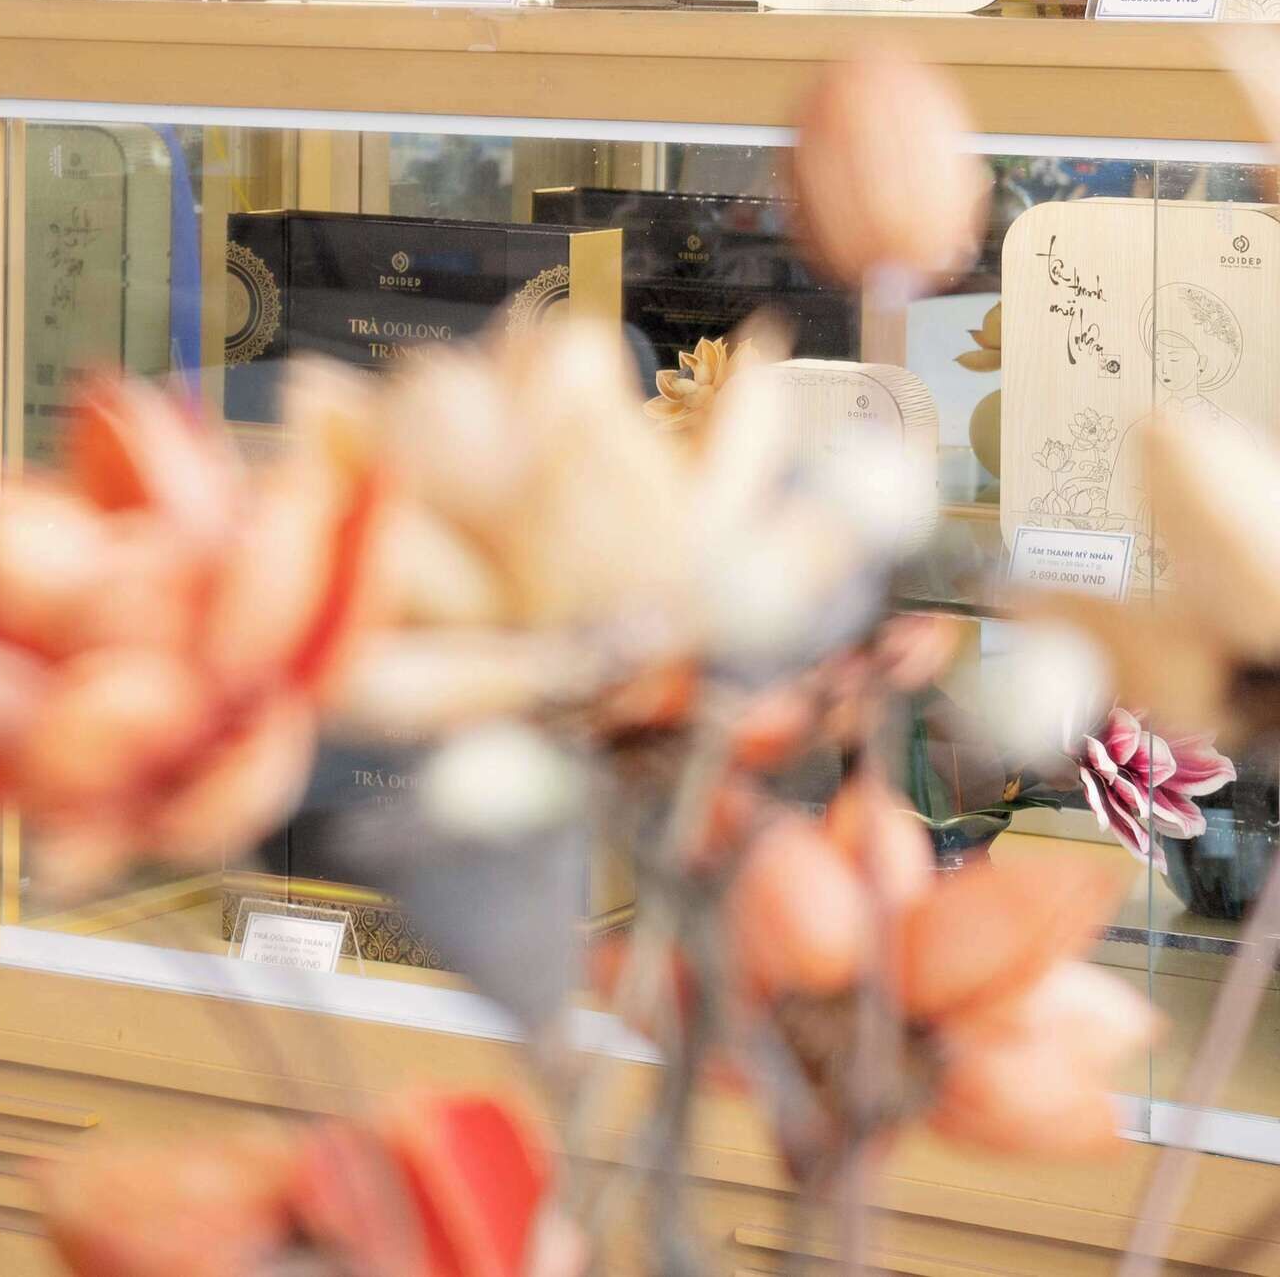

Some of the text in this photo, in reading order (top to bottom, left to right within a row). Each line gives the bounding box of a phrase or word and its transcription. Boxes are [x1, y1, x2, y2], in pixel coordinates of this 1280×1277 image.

[1220, 256, 1262, 266] DOIDEP
[380, 275, 421, 287] DOIDEP
[383, 322, 452, 340] OOLONG
[1030, 569, 1107, 586] 2.699.000 VND
